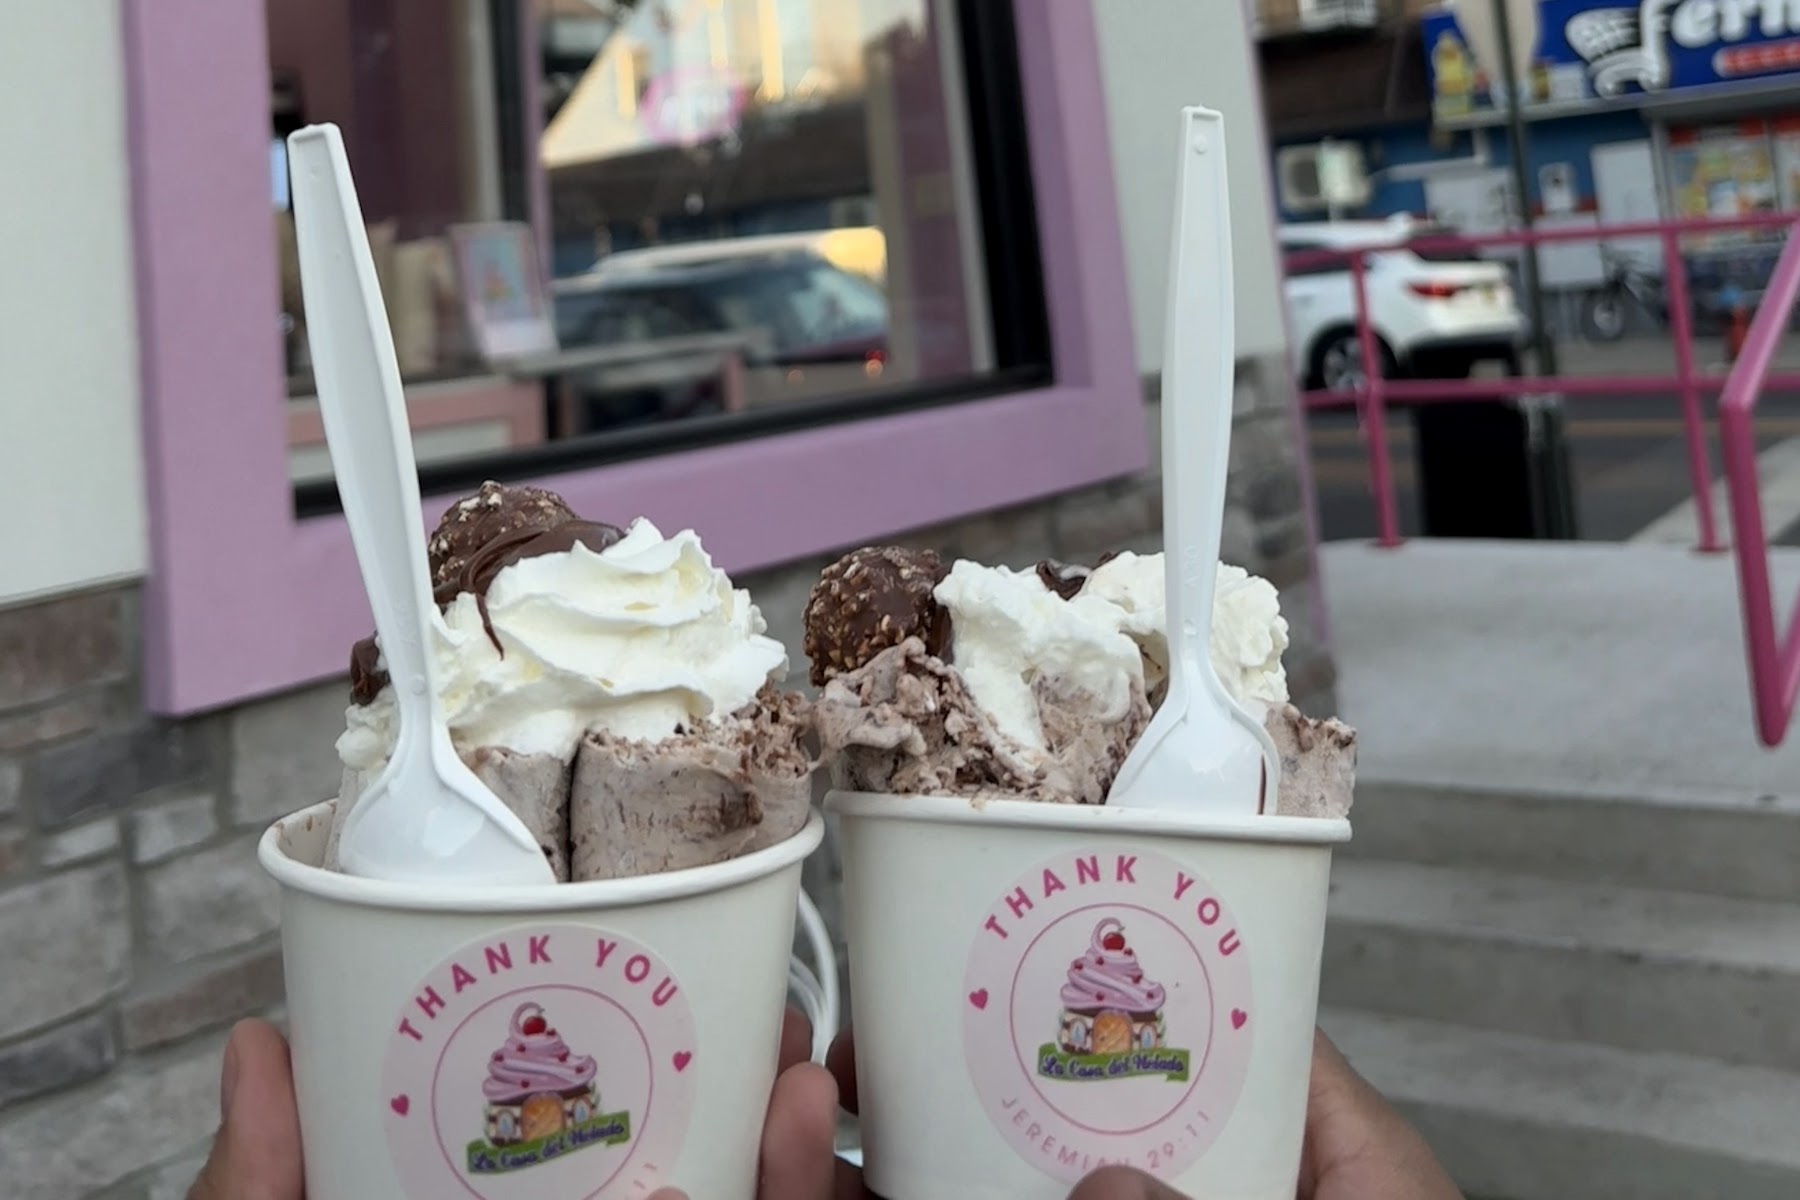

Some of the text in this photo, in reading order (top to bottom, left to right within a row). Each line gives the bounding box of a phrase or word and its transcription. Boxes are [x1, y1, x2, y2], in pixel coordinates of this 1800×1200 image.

[984, 854, 1241, 957] THANK YOU
[398, 934, 679, 1042] THANK YOU
[1042, 1056, 1064, 1075] La
[1108, 1057, 1129, 1075] del
[1133, 1055, 1184, 1072] Helado
